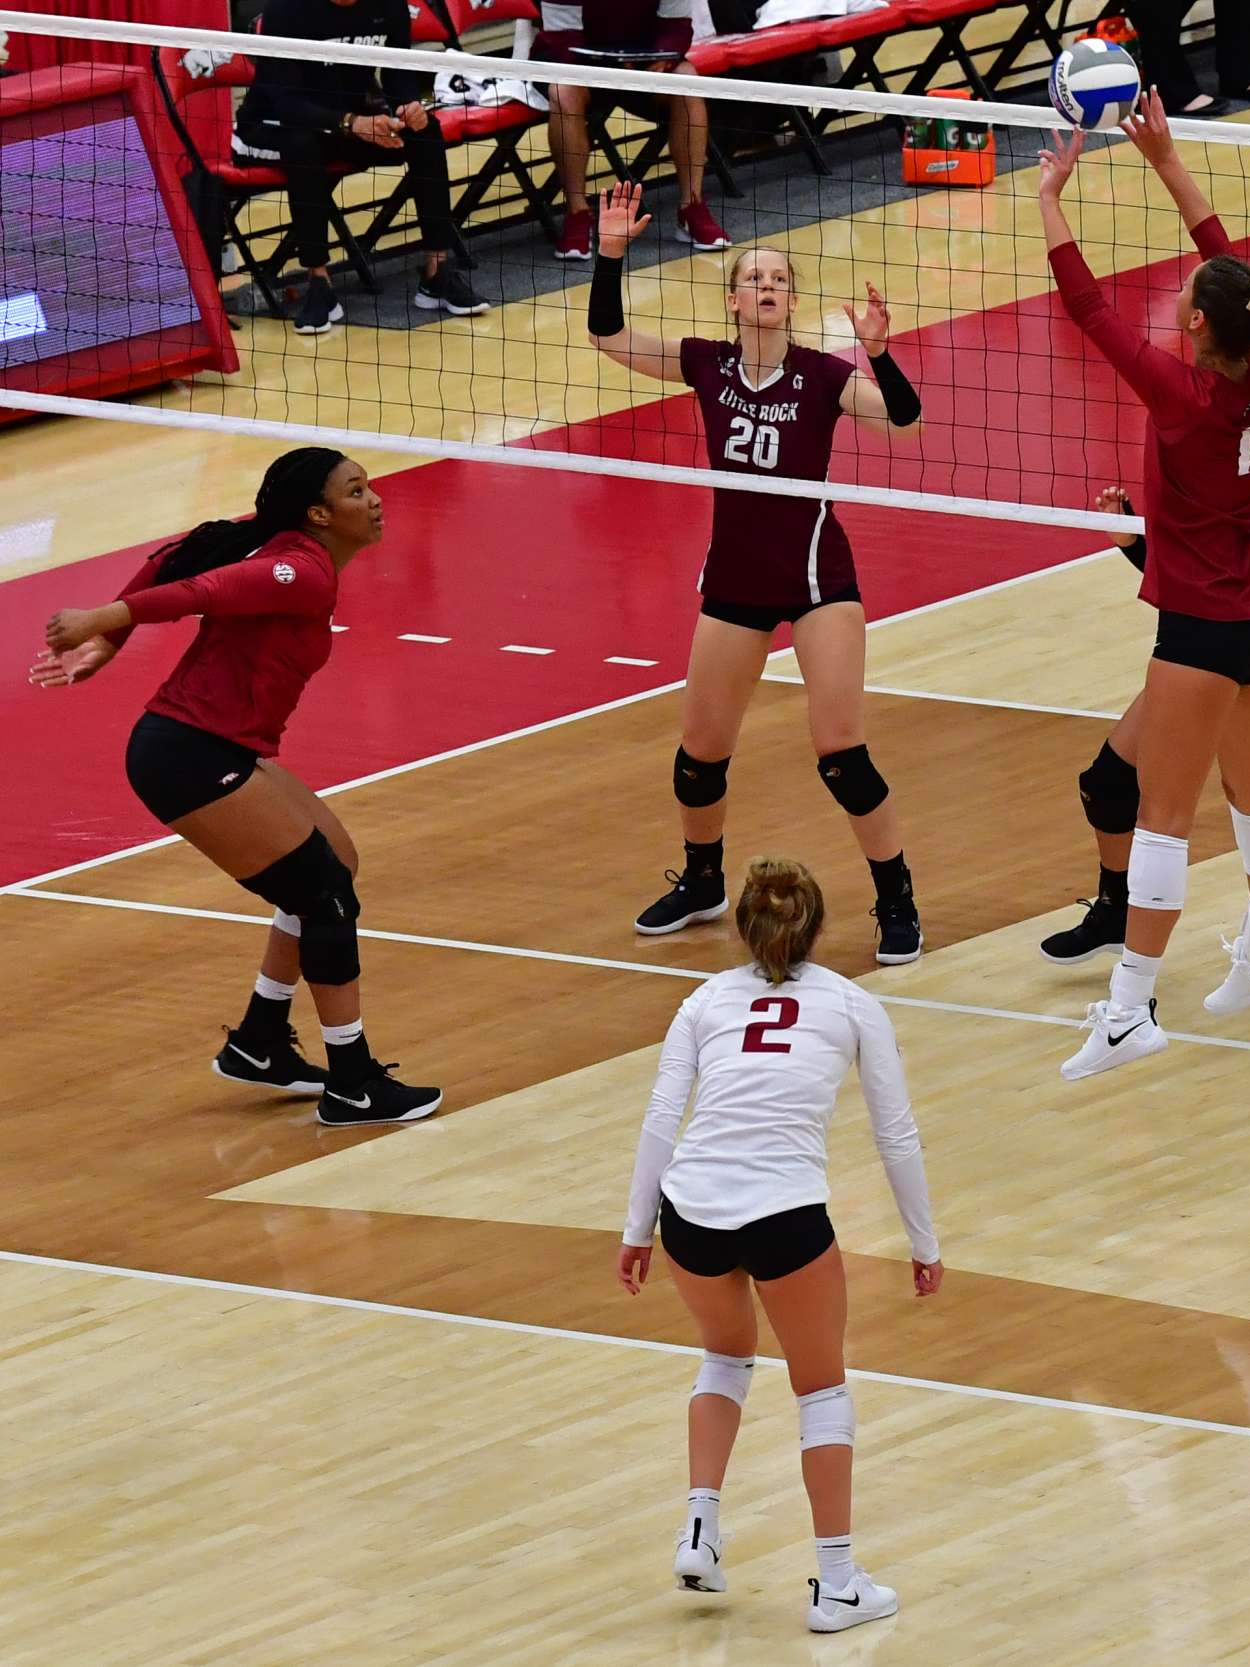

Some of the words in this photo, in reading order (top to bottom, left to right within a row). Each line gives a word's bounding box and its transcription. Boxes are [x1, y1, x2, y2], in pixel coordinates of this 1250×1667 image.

[718, 385, 757, 418] LITTLE
[758, 401, 800, 423] ROCK
[723, 415, 780, 470] 20
[741, 996, 800, 1054] 2
